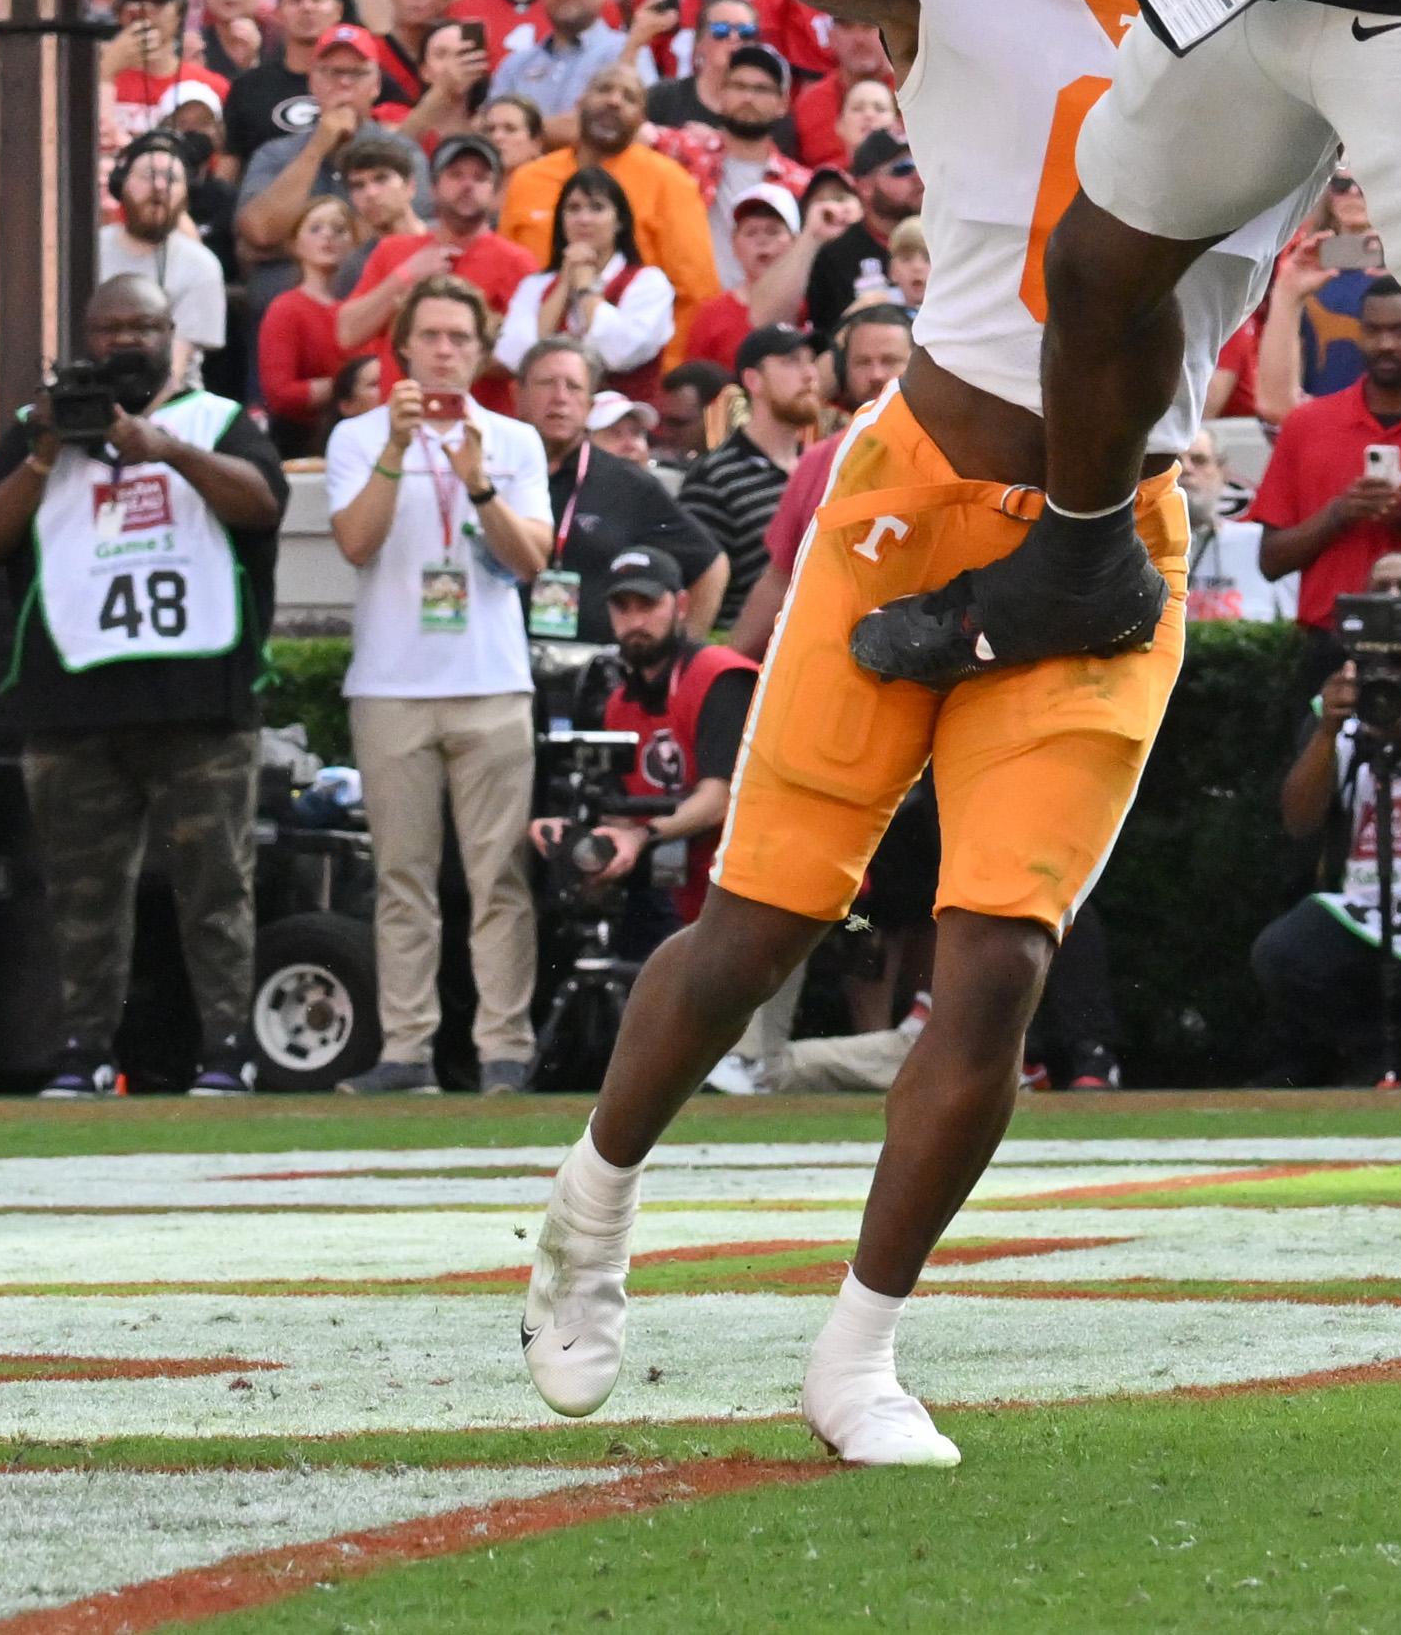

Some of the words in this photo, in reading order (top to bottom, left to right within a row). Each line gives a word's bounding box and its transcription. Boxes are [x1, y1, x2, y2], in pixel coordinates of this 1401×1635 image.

[94, 537, 158, 560] Game
[852, 514, 910, 563] T
[99, 570, 188, 639] 48
